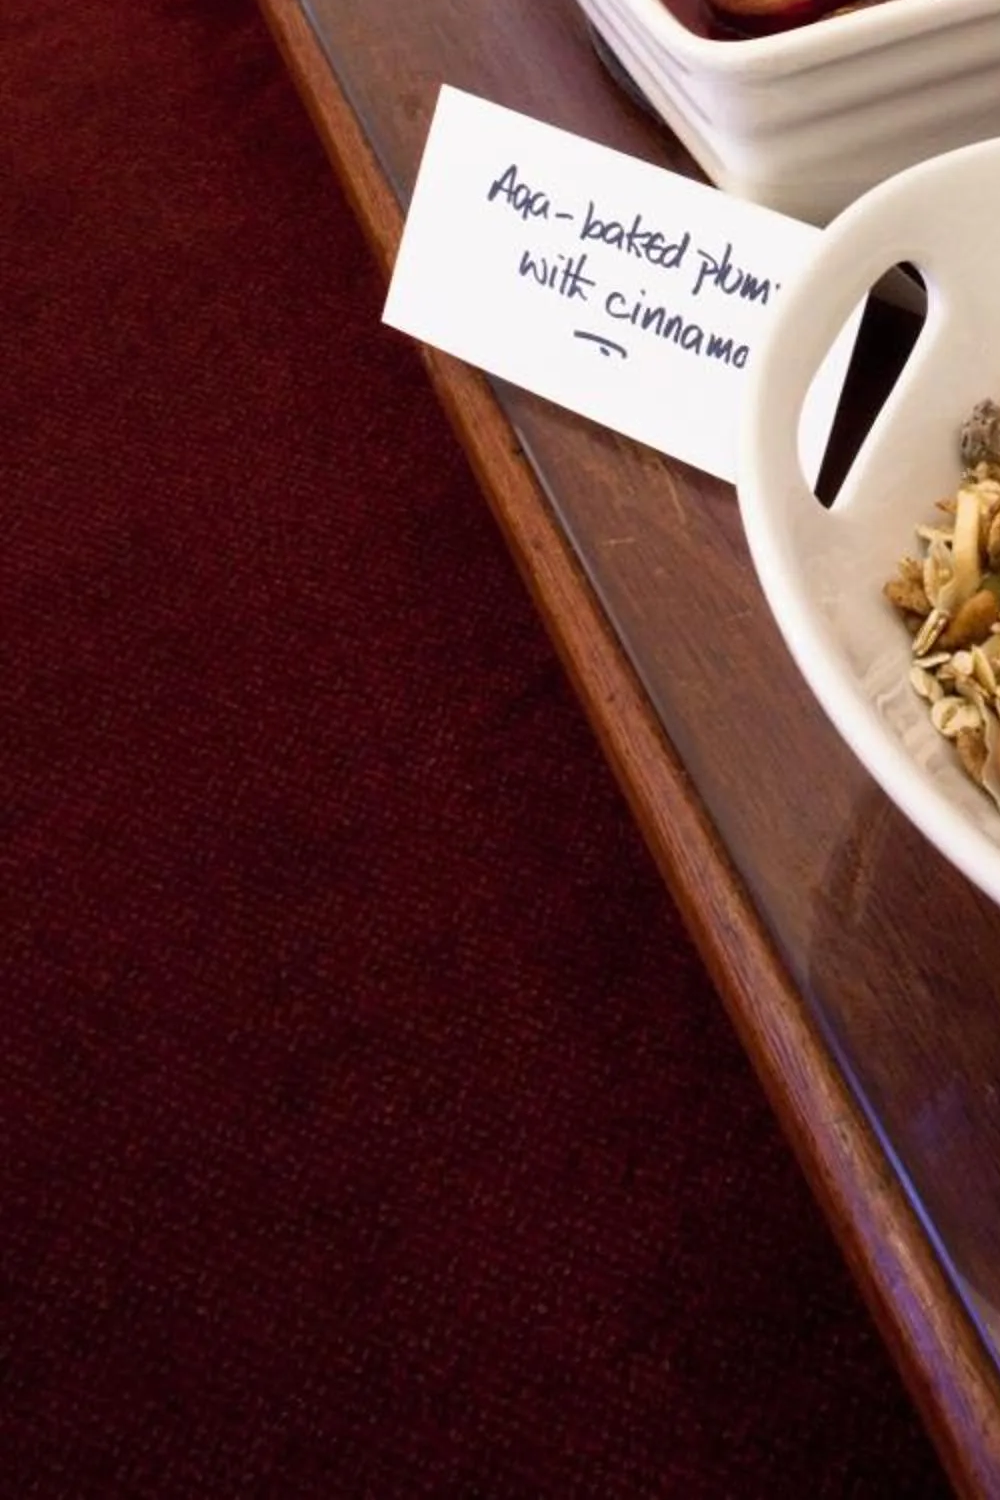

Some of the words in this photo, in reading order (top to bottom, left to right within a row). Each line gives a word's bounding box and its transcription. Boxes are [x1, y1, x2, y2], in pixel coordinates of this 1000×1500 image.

[519, 249, 596, 302] with
[605, 288, 751, 369] cinnamo
[692, 243, 772, 306] plum
